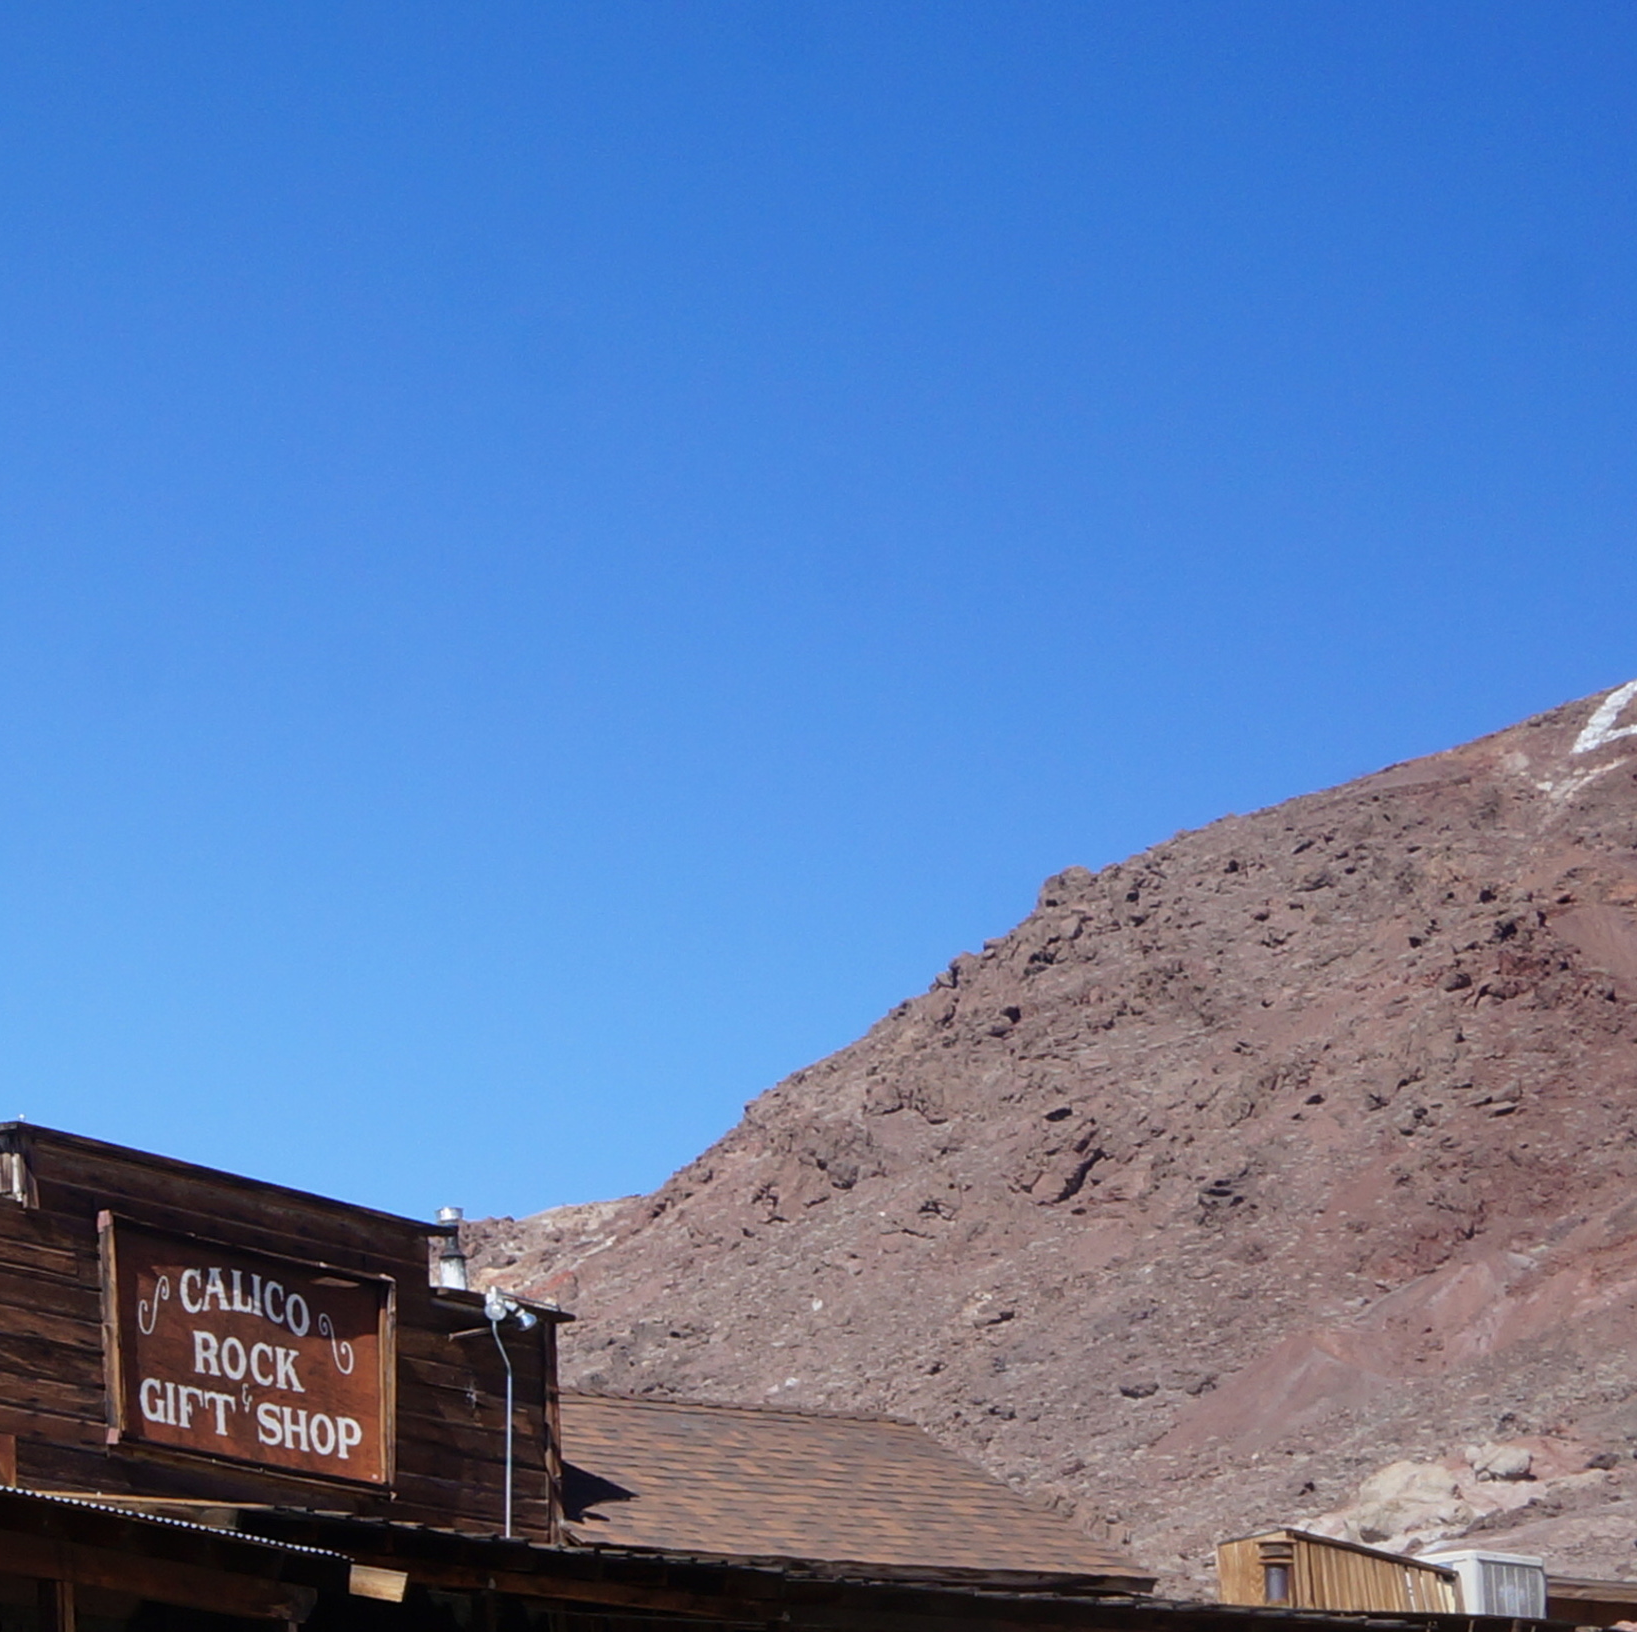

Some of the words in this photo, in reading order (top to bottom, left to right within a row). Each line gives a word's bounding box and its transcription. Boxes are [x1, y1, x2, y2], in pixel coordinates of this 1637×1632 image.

[179, 1267, 311, 1337] CALICO
[192, 1329, 306, 1393] ROCK
[139, 1377, 236, 1436] GIFT
[256, 1402, 363, 1459] SHOP
